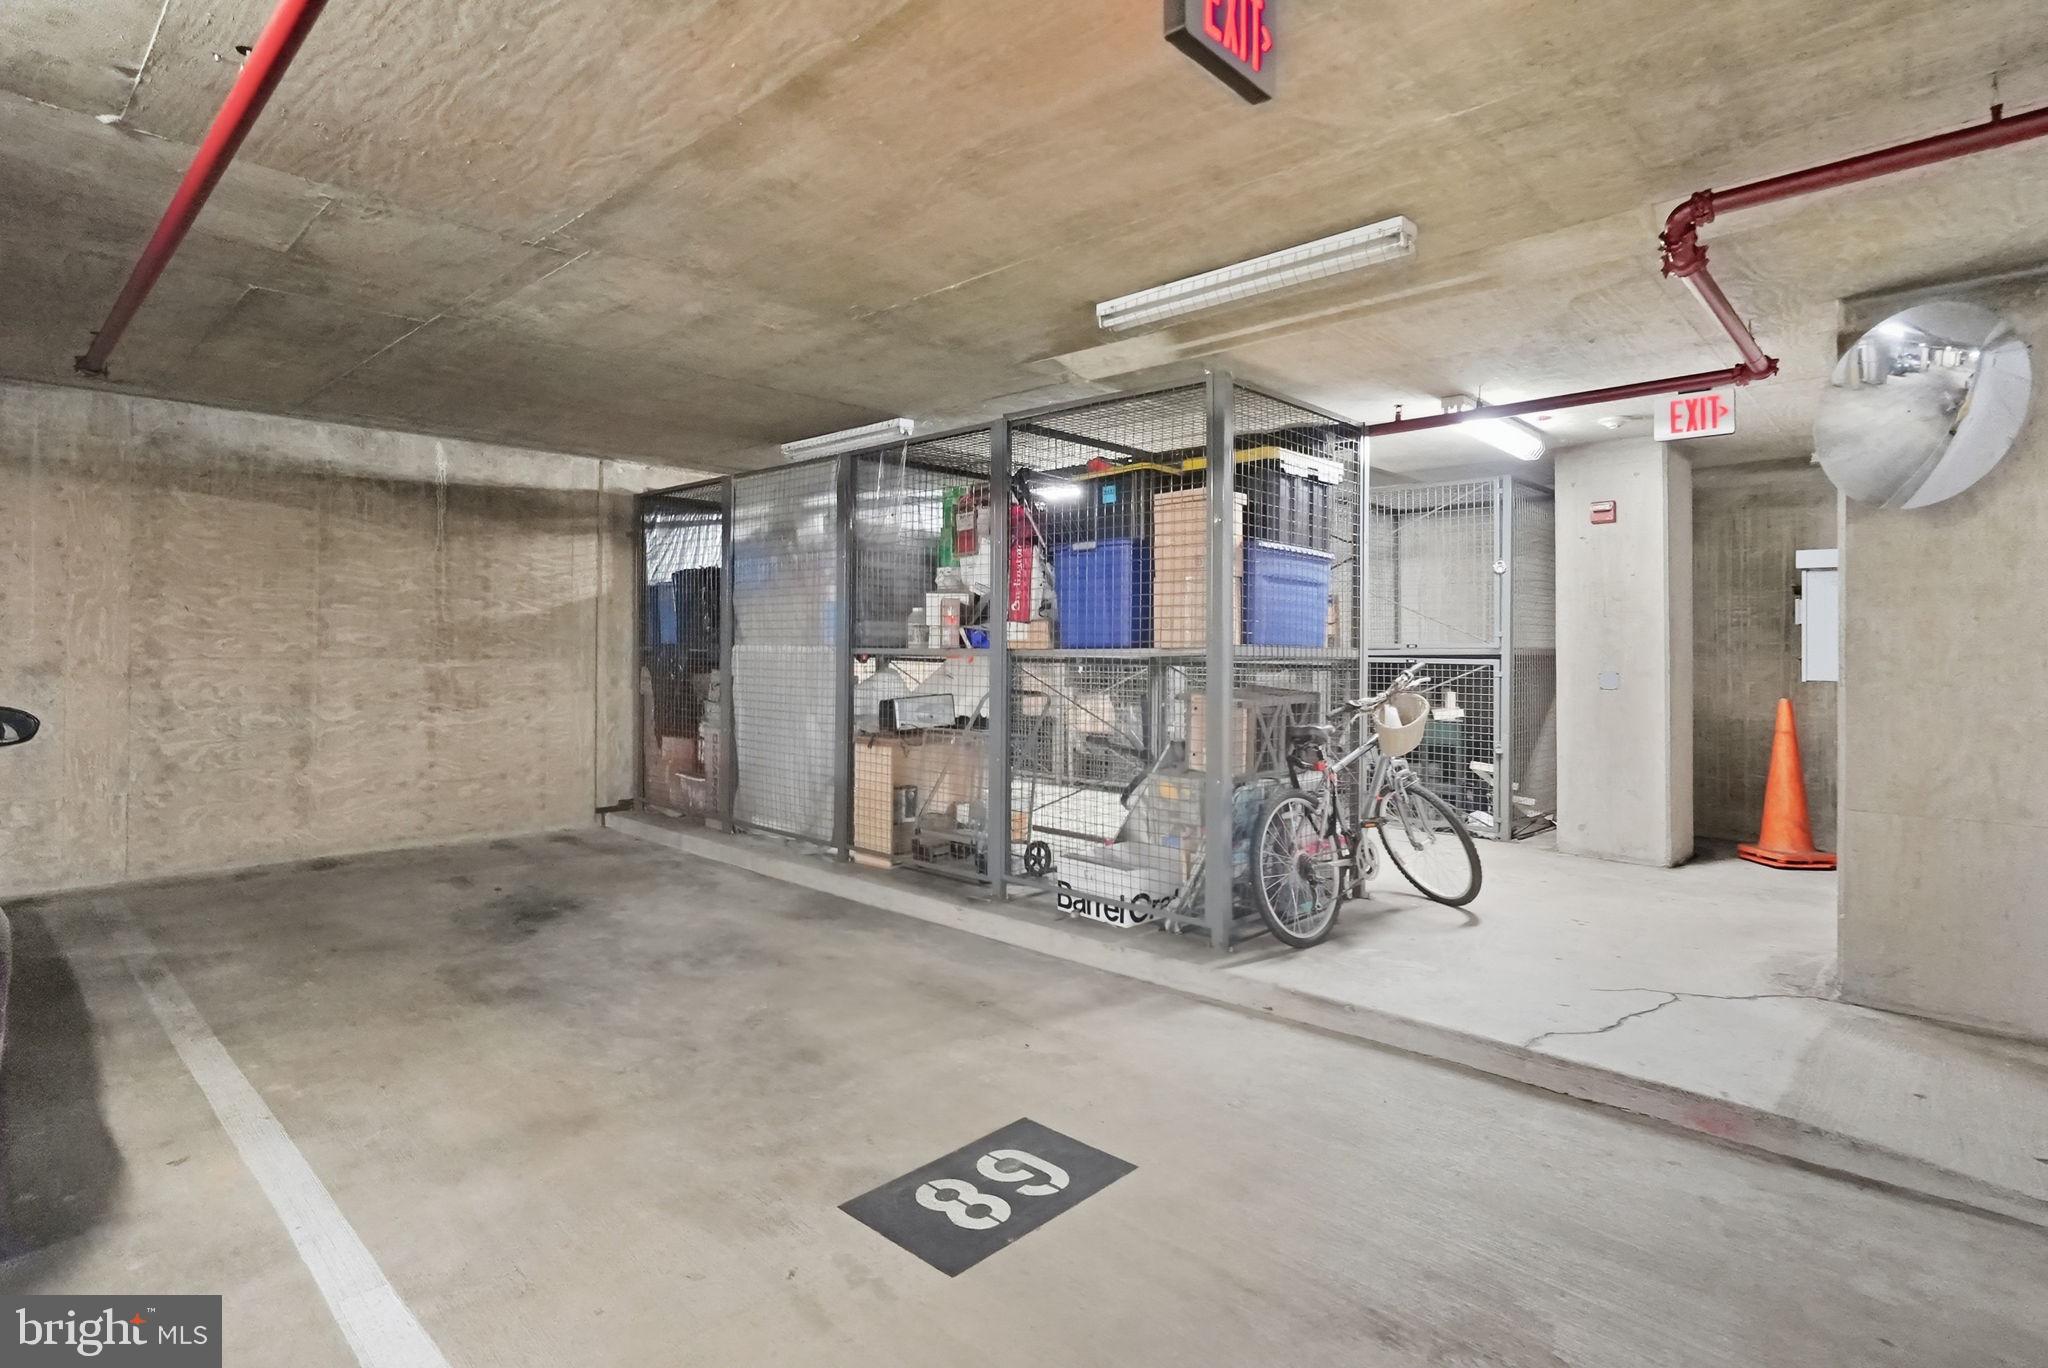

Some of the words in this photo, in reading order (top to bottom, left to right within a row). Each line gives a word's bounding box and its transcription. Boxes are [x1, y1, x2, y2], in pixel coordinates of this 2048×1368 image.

[1203, 0, 1265, 73] EXIT
[1670, 394, 1720, 434] EXIT
[915, 1149, 1070, 1230] 89
